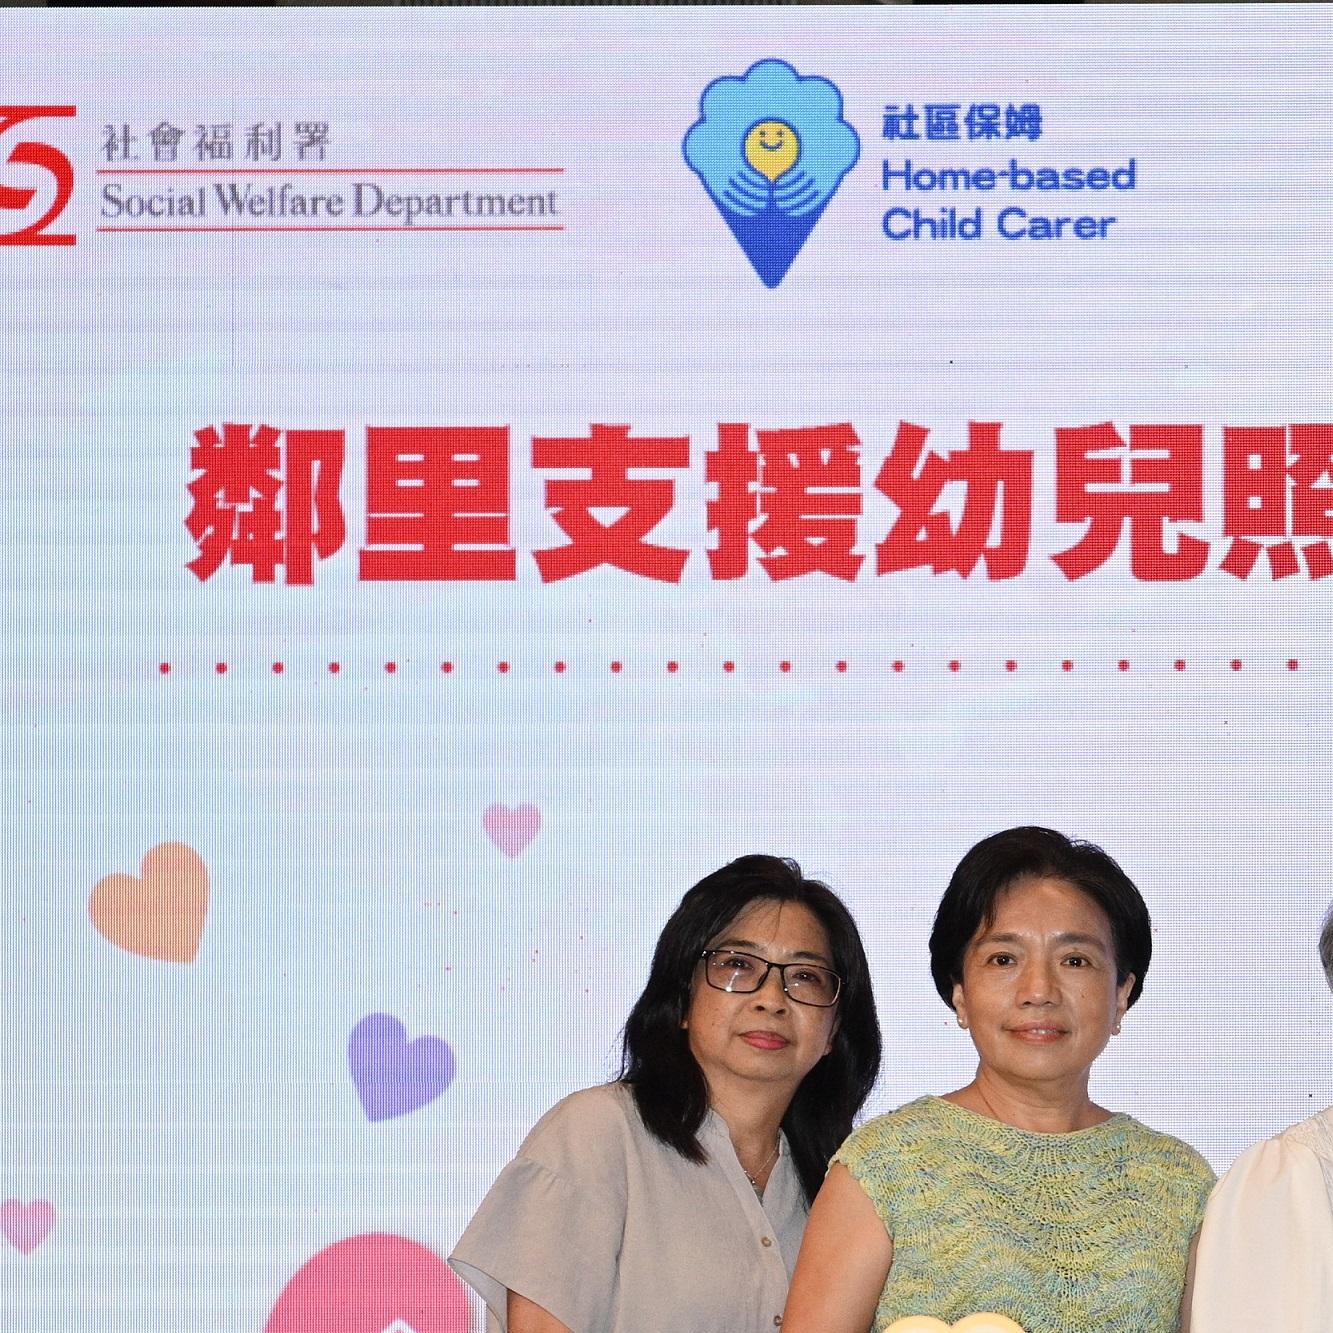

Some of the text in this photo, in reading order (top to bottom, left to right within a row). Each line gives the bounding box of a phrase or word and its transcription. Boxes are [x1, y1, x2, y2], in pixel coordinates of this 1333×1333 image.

[882, 103, 1043, 141] 社區保姆
[100, 121, 332, 162] 社會福利署
[882, 157, 1136, 191] Home-based
[100, 183, 559, 225] Social Welfare Department
[882, 206, 1118, 240] Child Carer
